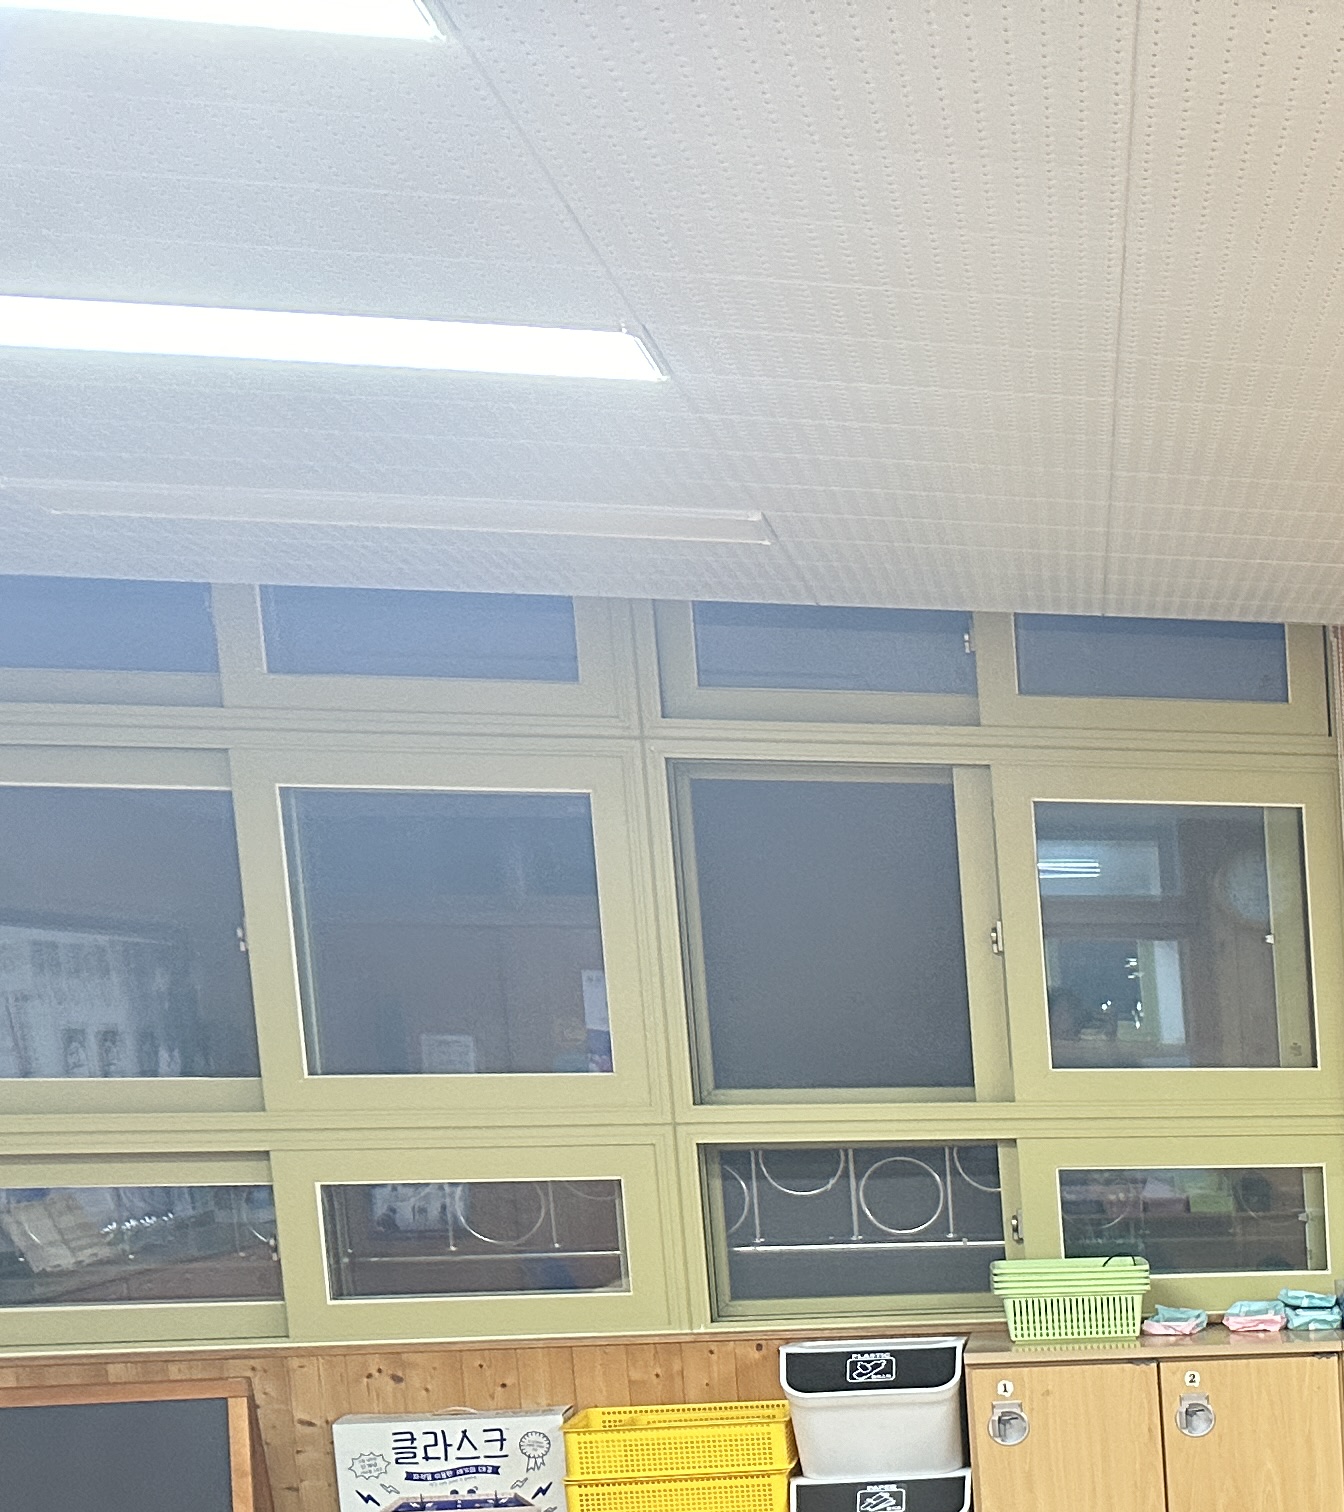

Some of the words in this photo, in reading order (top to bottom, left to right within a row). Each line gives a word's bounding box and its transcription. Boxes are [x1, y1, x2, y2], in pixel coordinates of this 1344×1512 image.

[1188, 1373, 1196, 1384] 2
[1002, 1383, 1009, 1393] 1
[391, 1428, 510, 1465] 클라스크
